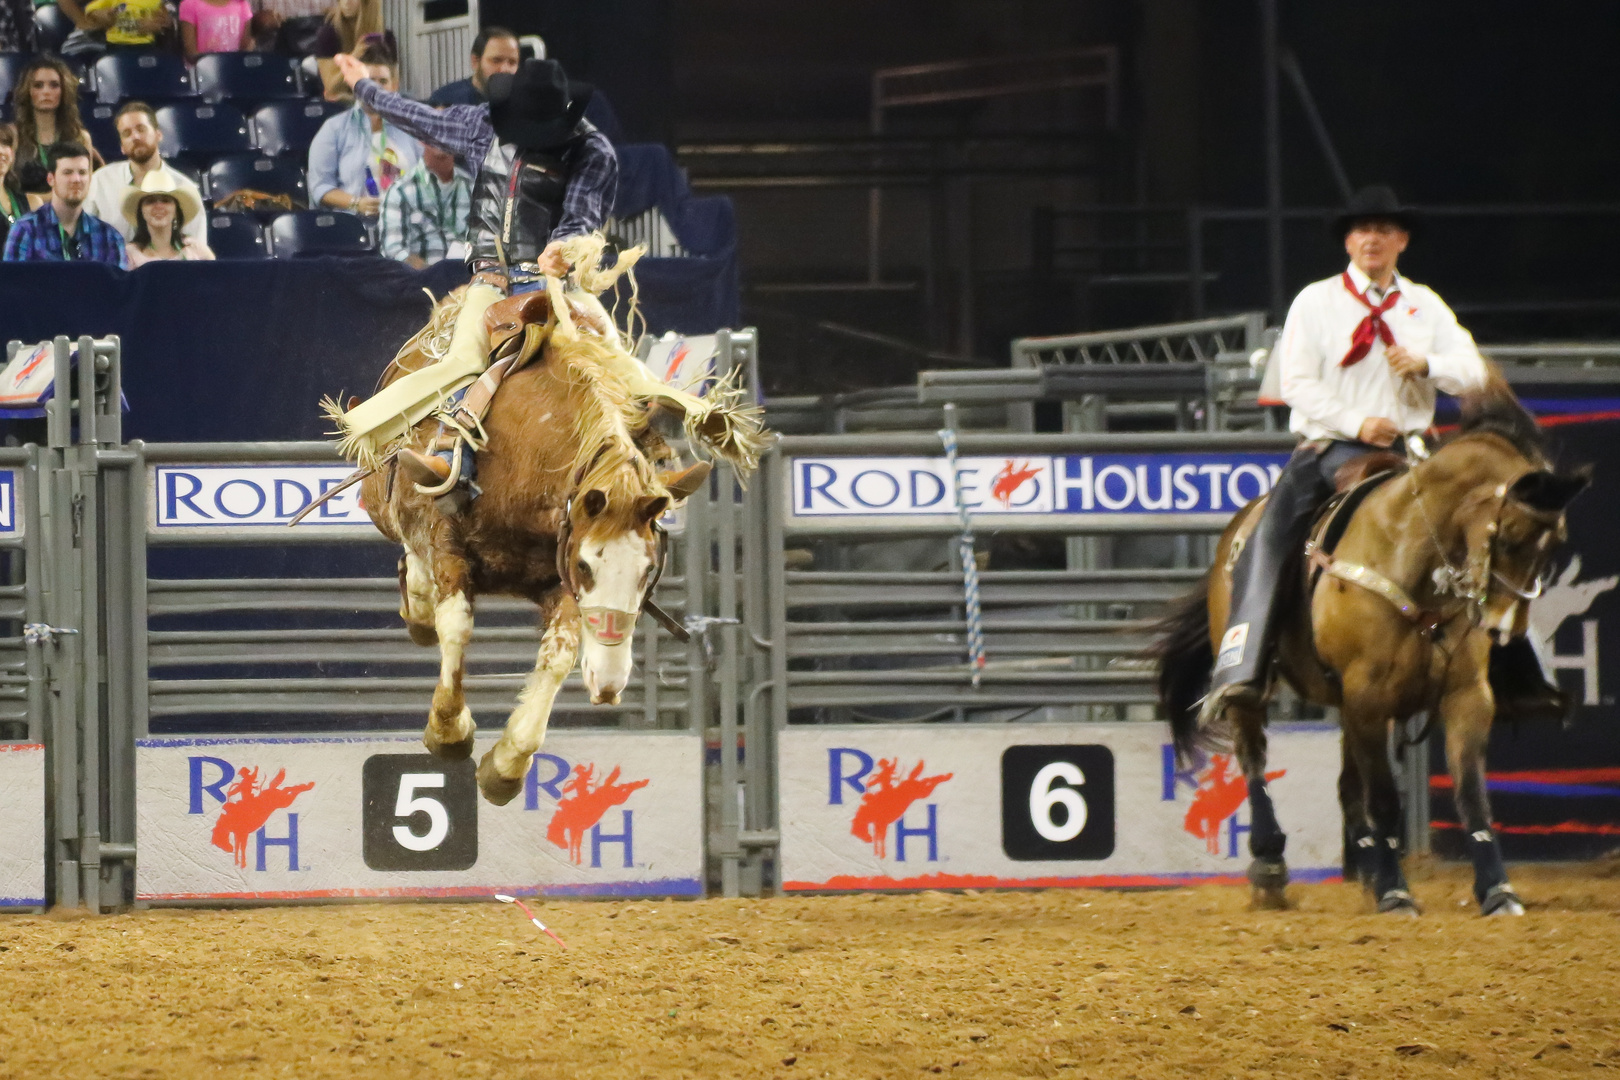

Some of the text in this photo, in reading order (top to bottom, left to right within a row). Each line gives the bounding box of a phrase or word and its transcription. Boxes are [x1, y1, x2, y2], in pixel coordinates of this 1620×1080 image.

[503, 197, 514, 243] PHOENIX
[164, 472, 361, 519] RODE
[187, 756, 236, 814] R
[827, 747, 874, 804] R
[1029, 761, 1088, 842] 6
[392, 773, 449, 851] 5
[589, 809, 634, 868] H
[895, 803, 939, 862] H
[255, 812, 300, 872] H
